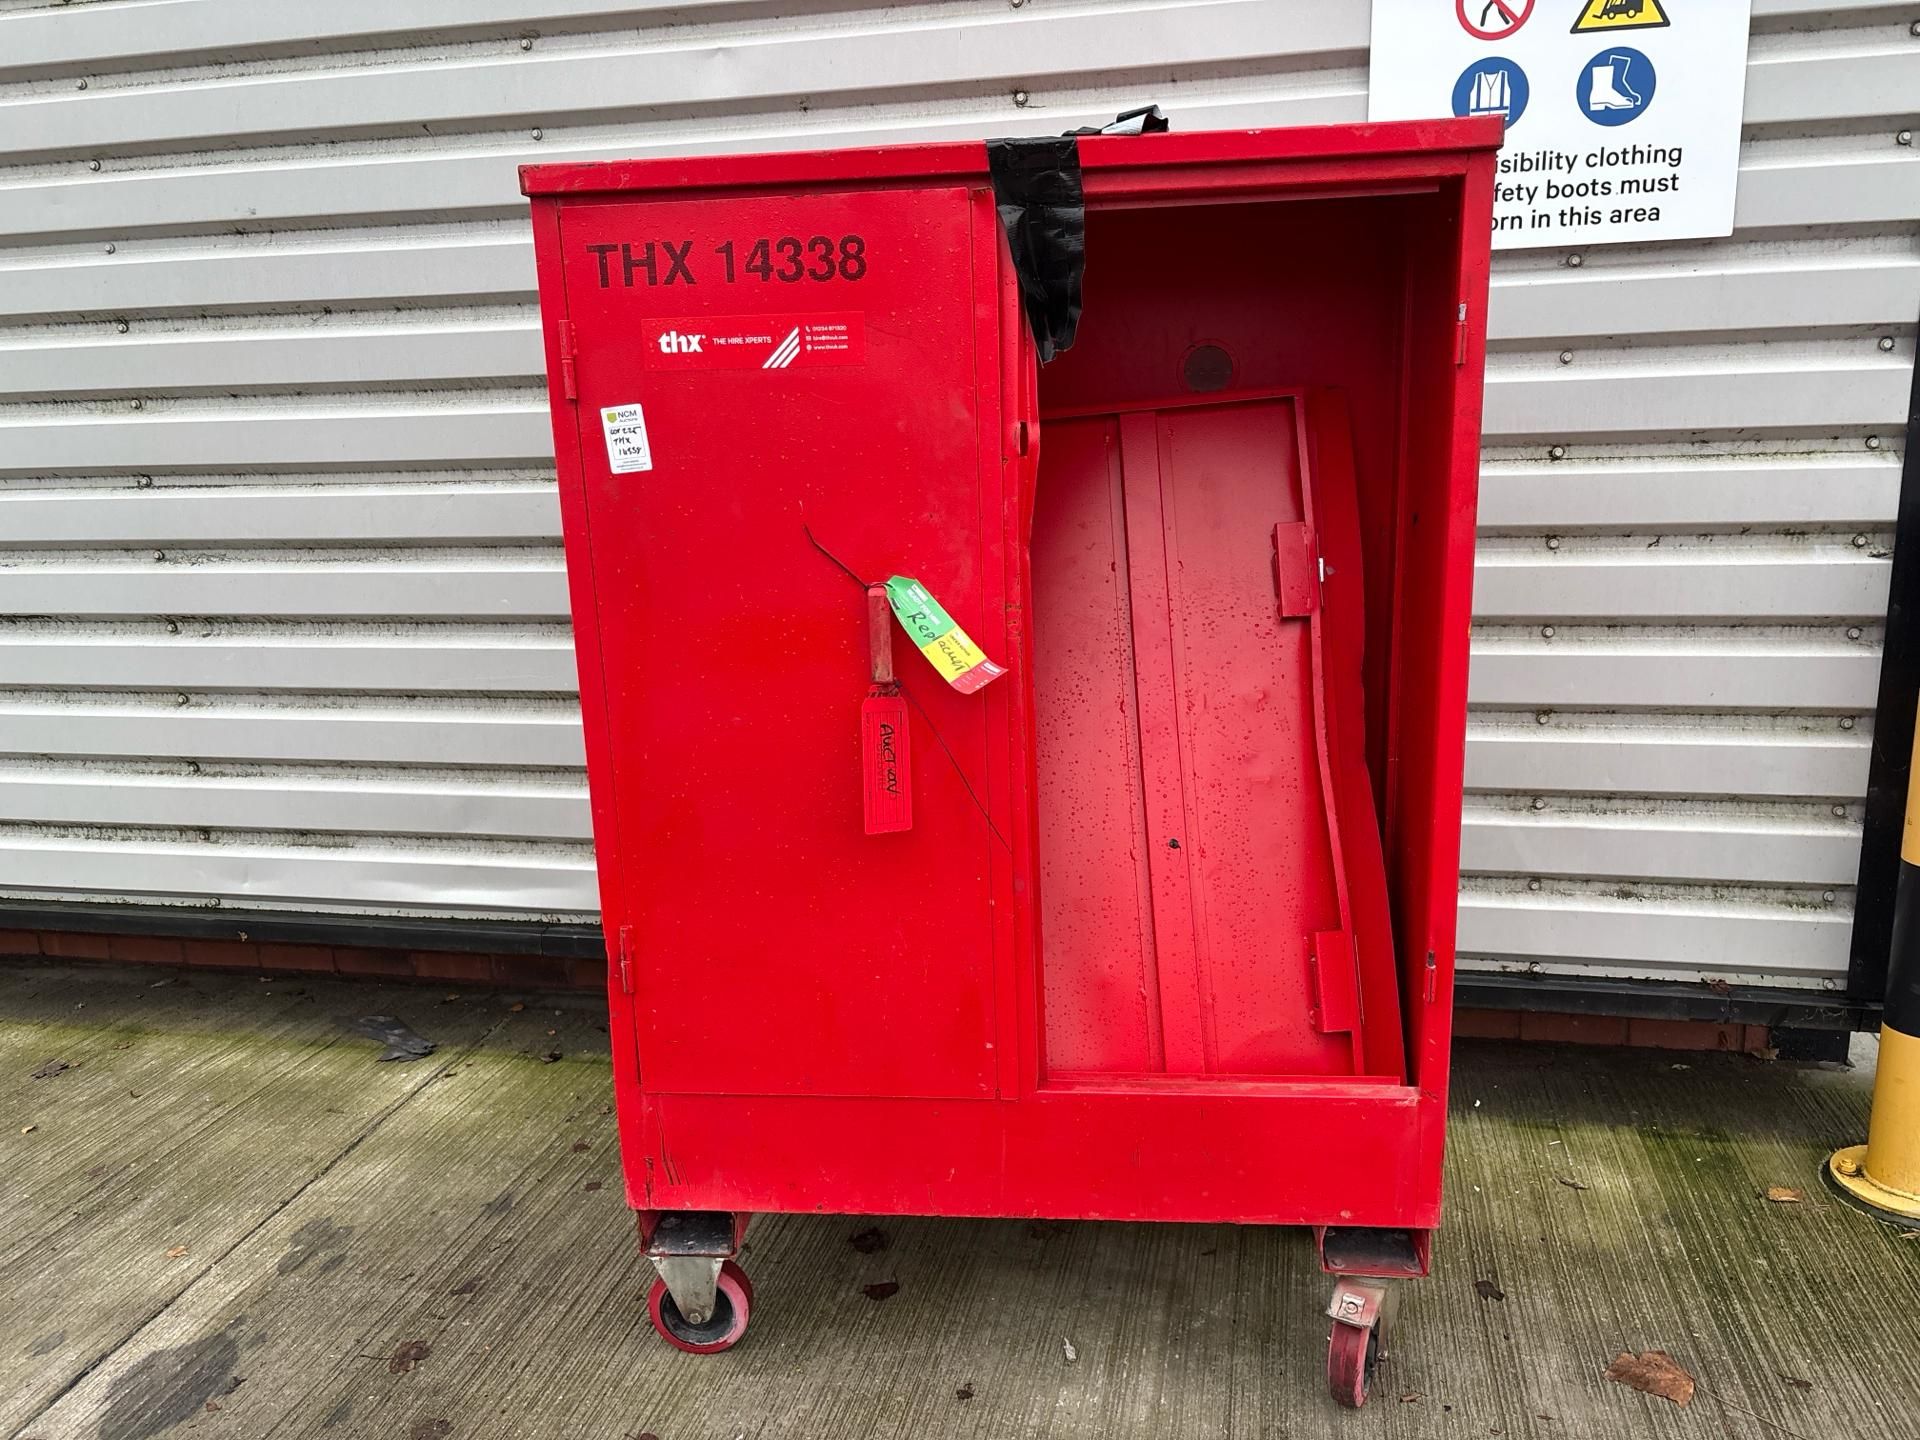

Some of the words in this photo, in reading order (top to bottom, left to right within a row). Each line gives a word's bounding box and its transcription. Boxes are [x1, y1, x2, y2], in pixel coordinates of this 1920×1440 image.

[1495, 150, 1578, 174] isibility
[1585, 144, 1683, 168] clothing
[1494, 182, 1539, 206] fety
[1546, 177, 1612, 200] boots
[1620, 173, 1680, 195] must
[1491, 214, 1523, 231] orn
[1531, 209, 1551, 229] in
[1559, 206, 1602, 227] this
[1610, 205, 1661, 224] area
[586, 240, 697, 288] THX
[714, 234, 868, 284] 14338
[712, 337, 727, 345] THE
[728, 337, 744, 345] HIRE
[745, 336, 772, 345] XPERTS
[617, 409, 637, 418] NCM
[622, 426, 641, 435] 225
[613, 437, 631, 446] THX
